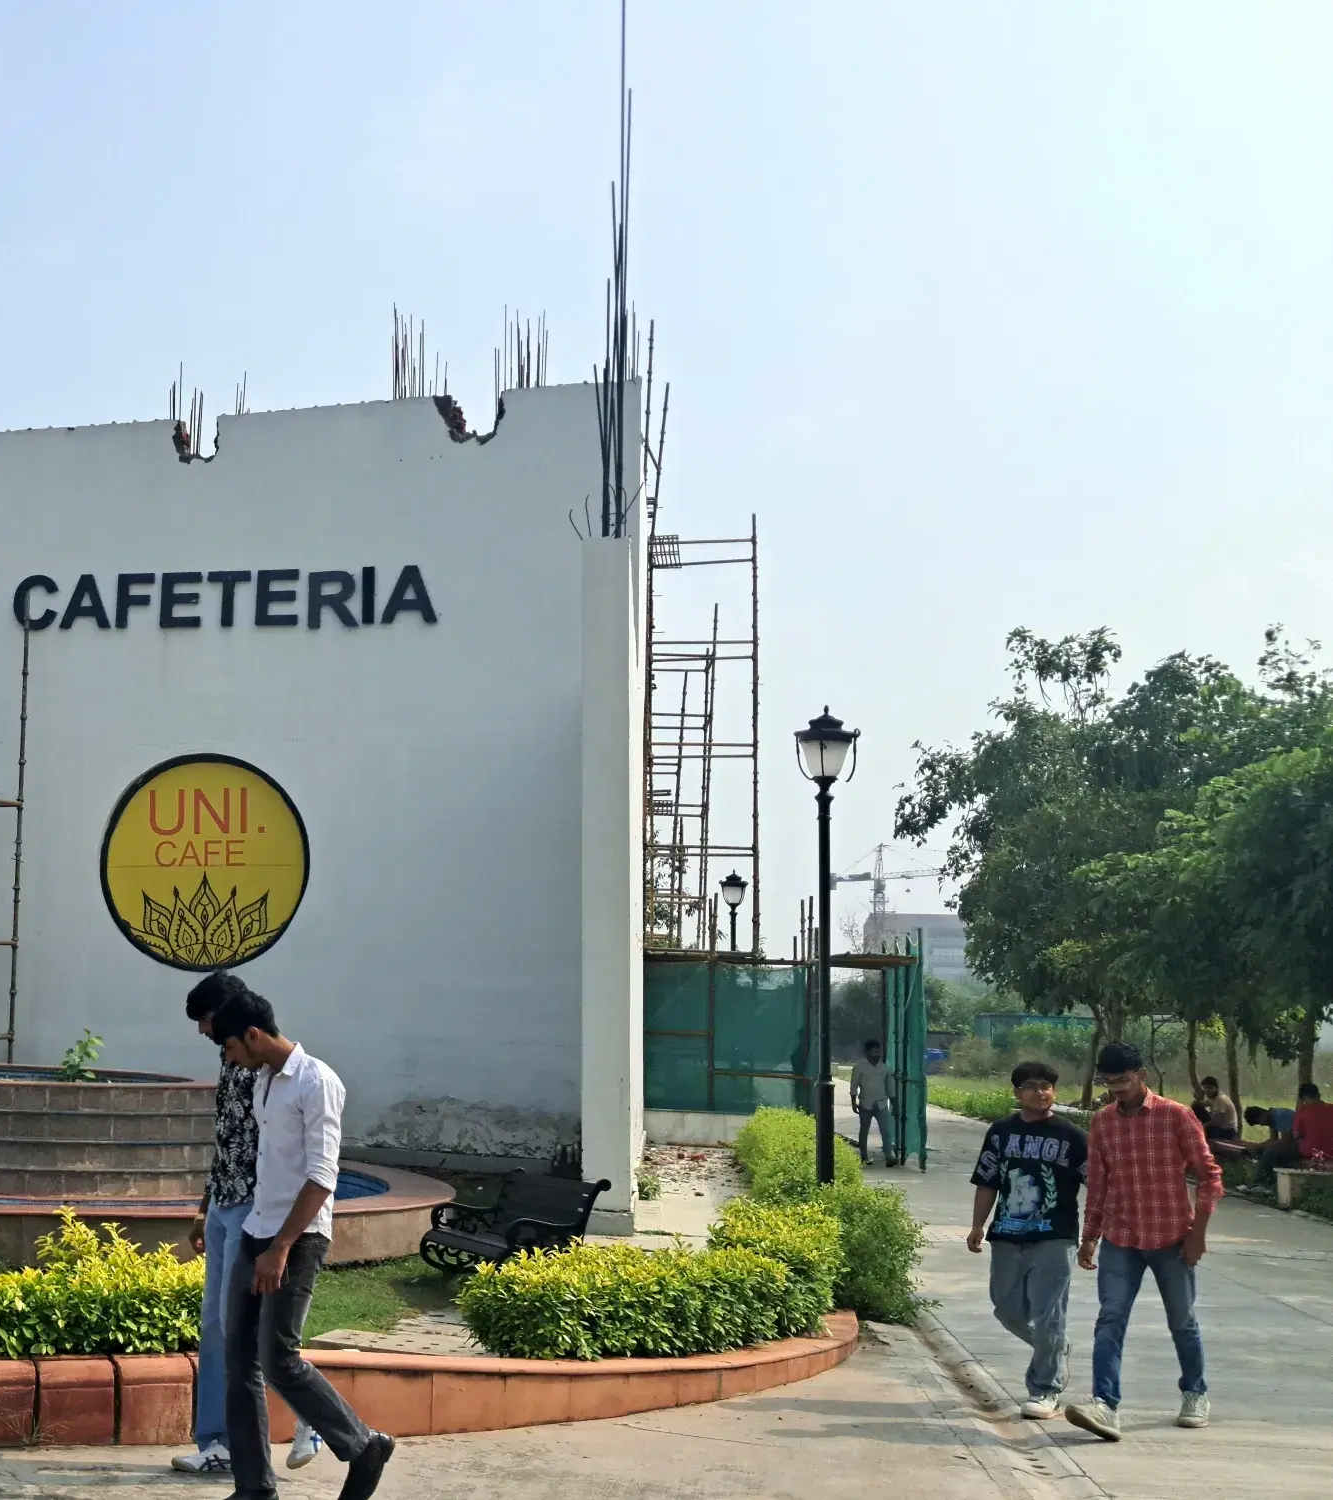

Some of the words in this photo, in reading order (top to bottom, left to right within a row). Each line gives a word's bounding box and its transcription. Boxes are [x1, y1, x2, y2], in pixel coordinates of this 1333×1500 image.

[13, 565, 438, 630] CAFETERIA
[148, 786, 266, 836] UNI.
[154, 840, 246, 869] CAFE
